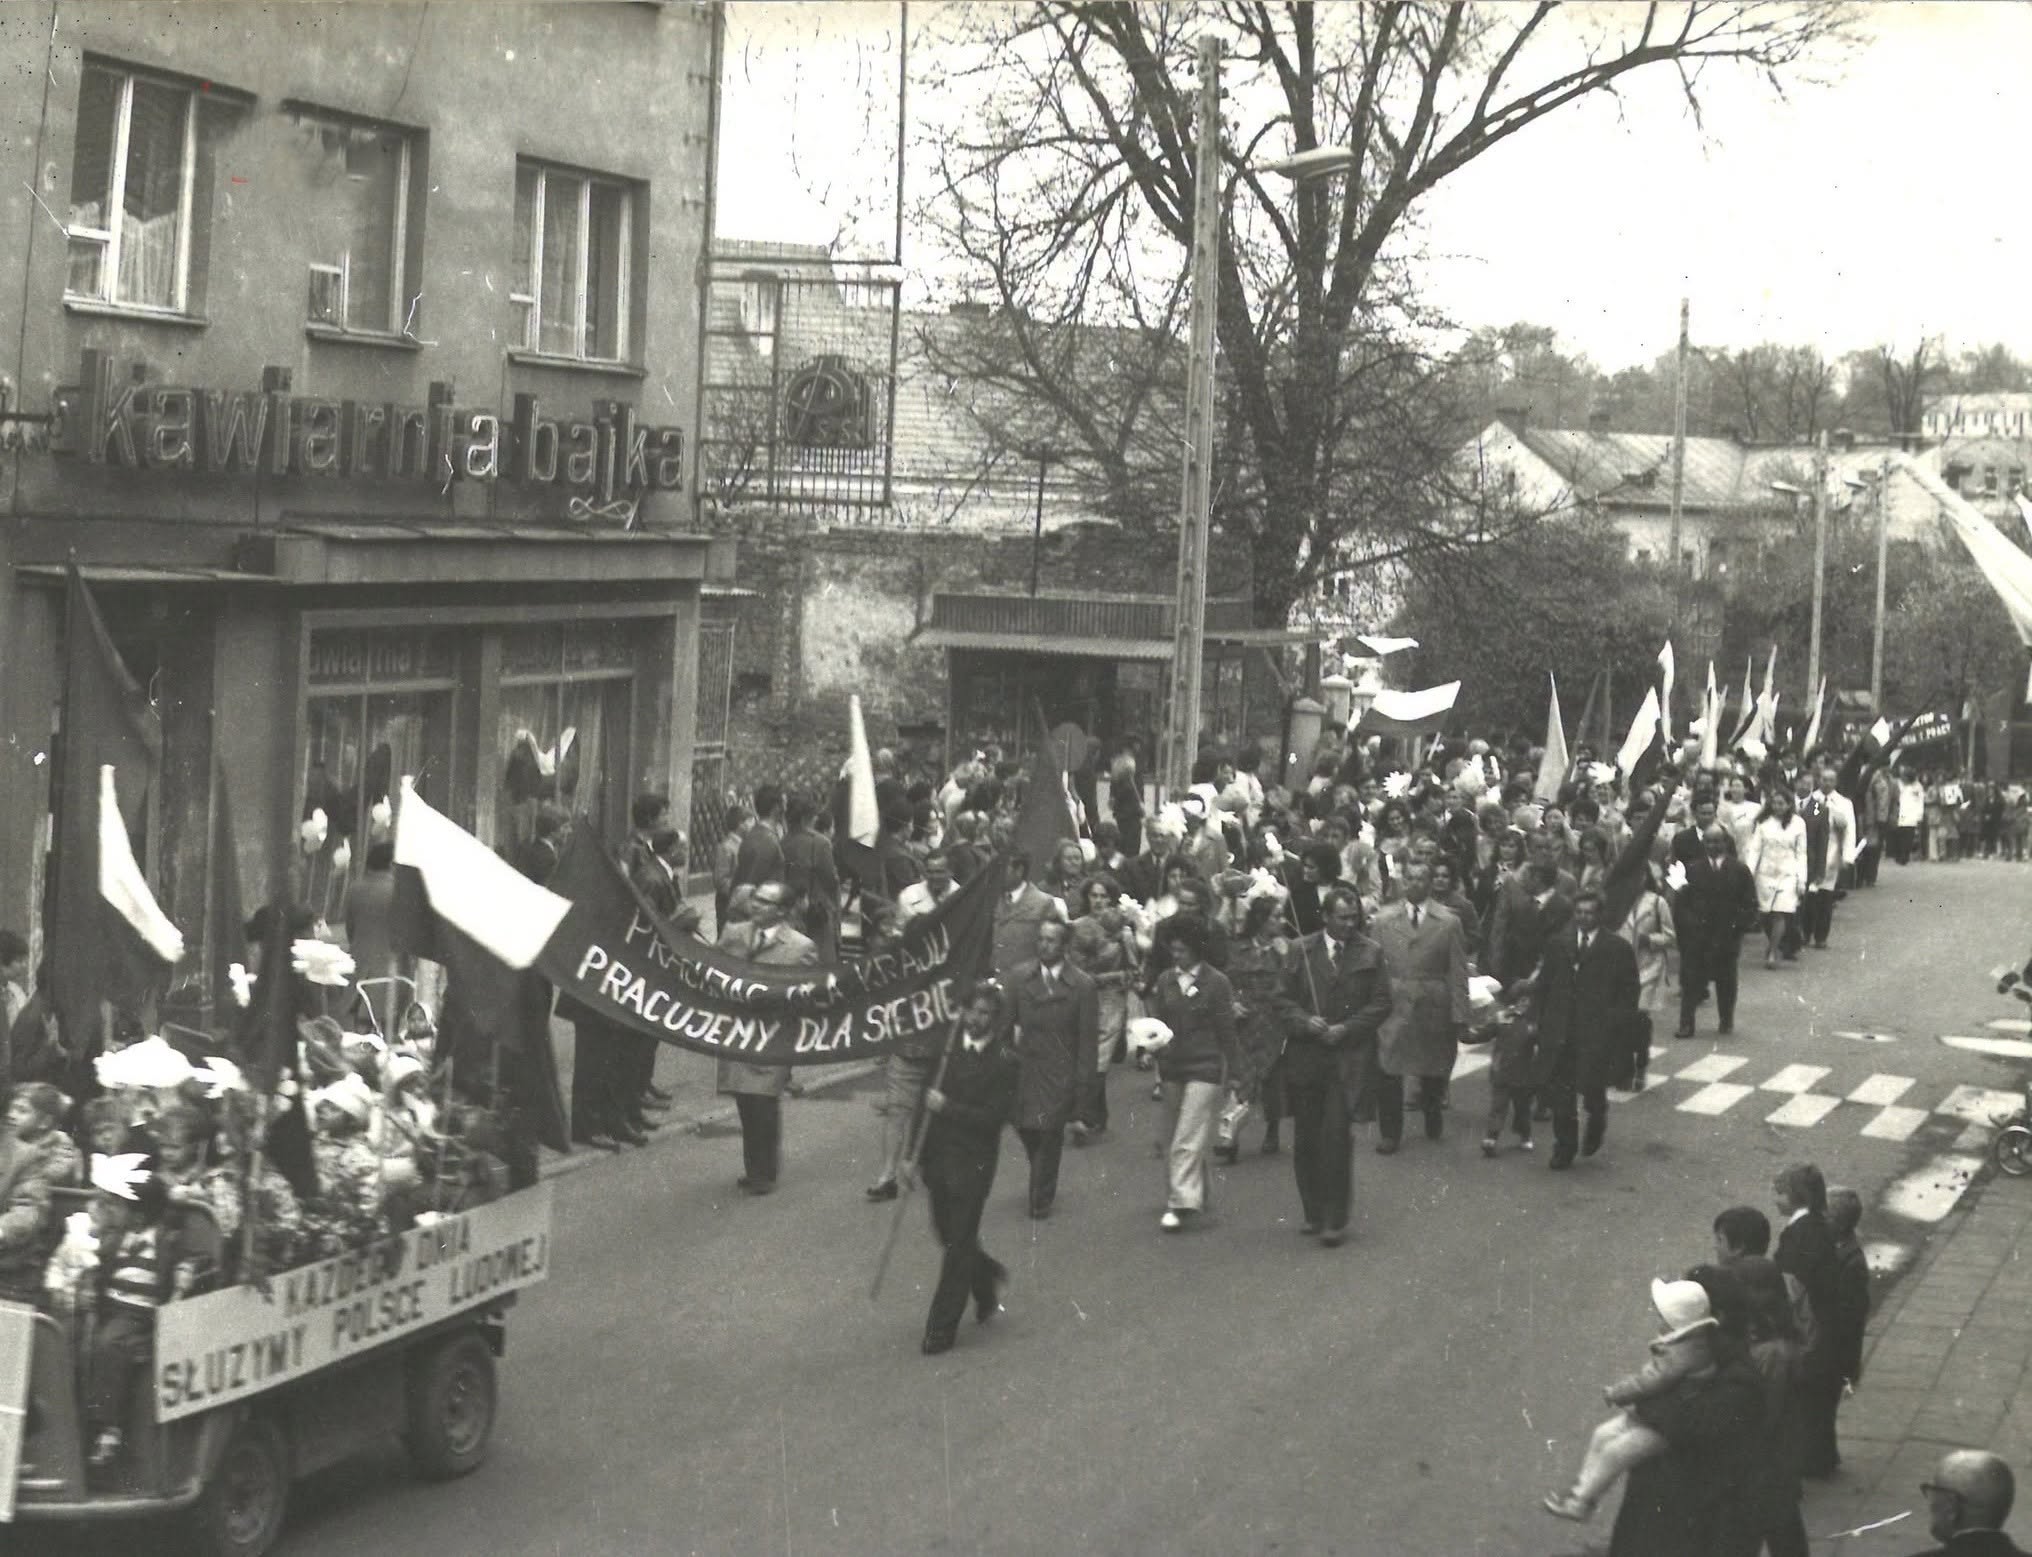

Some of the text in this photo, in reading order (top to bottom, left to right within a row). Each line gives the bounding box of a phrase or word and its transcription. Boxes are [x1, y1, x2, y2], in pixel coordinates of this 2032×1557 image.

[80, 348, 502, 482] kawiarnia
[514, 393, 688, 502] bajka
[575, 944, 962, 1053] PRACUJEMY DLA SIEBIE
[853, 921, 951, 992] KRAJU
[332, 1280, 426, 1351] POLSCE
[448, 1233, 548, 1306] LUDOWEJ
